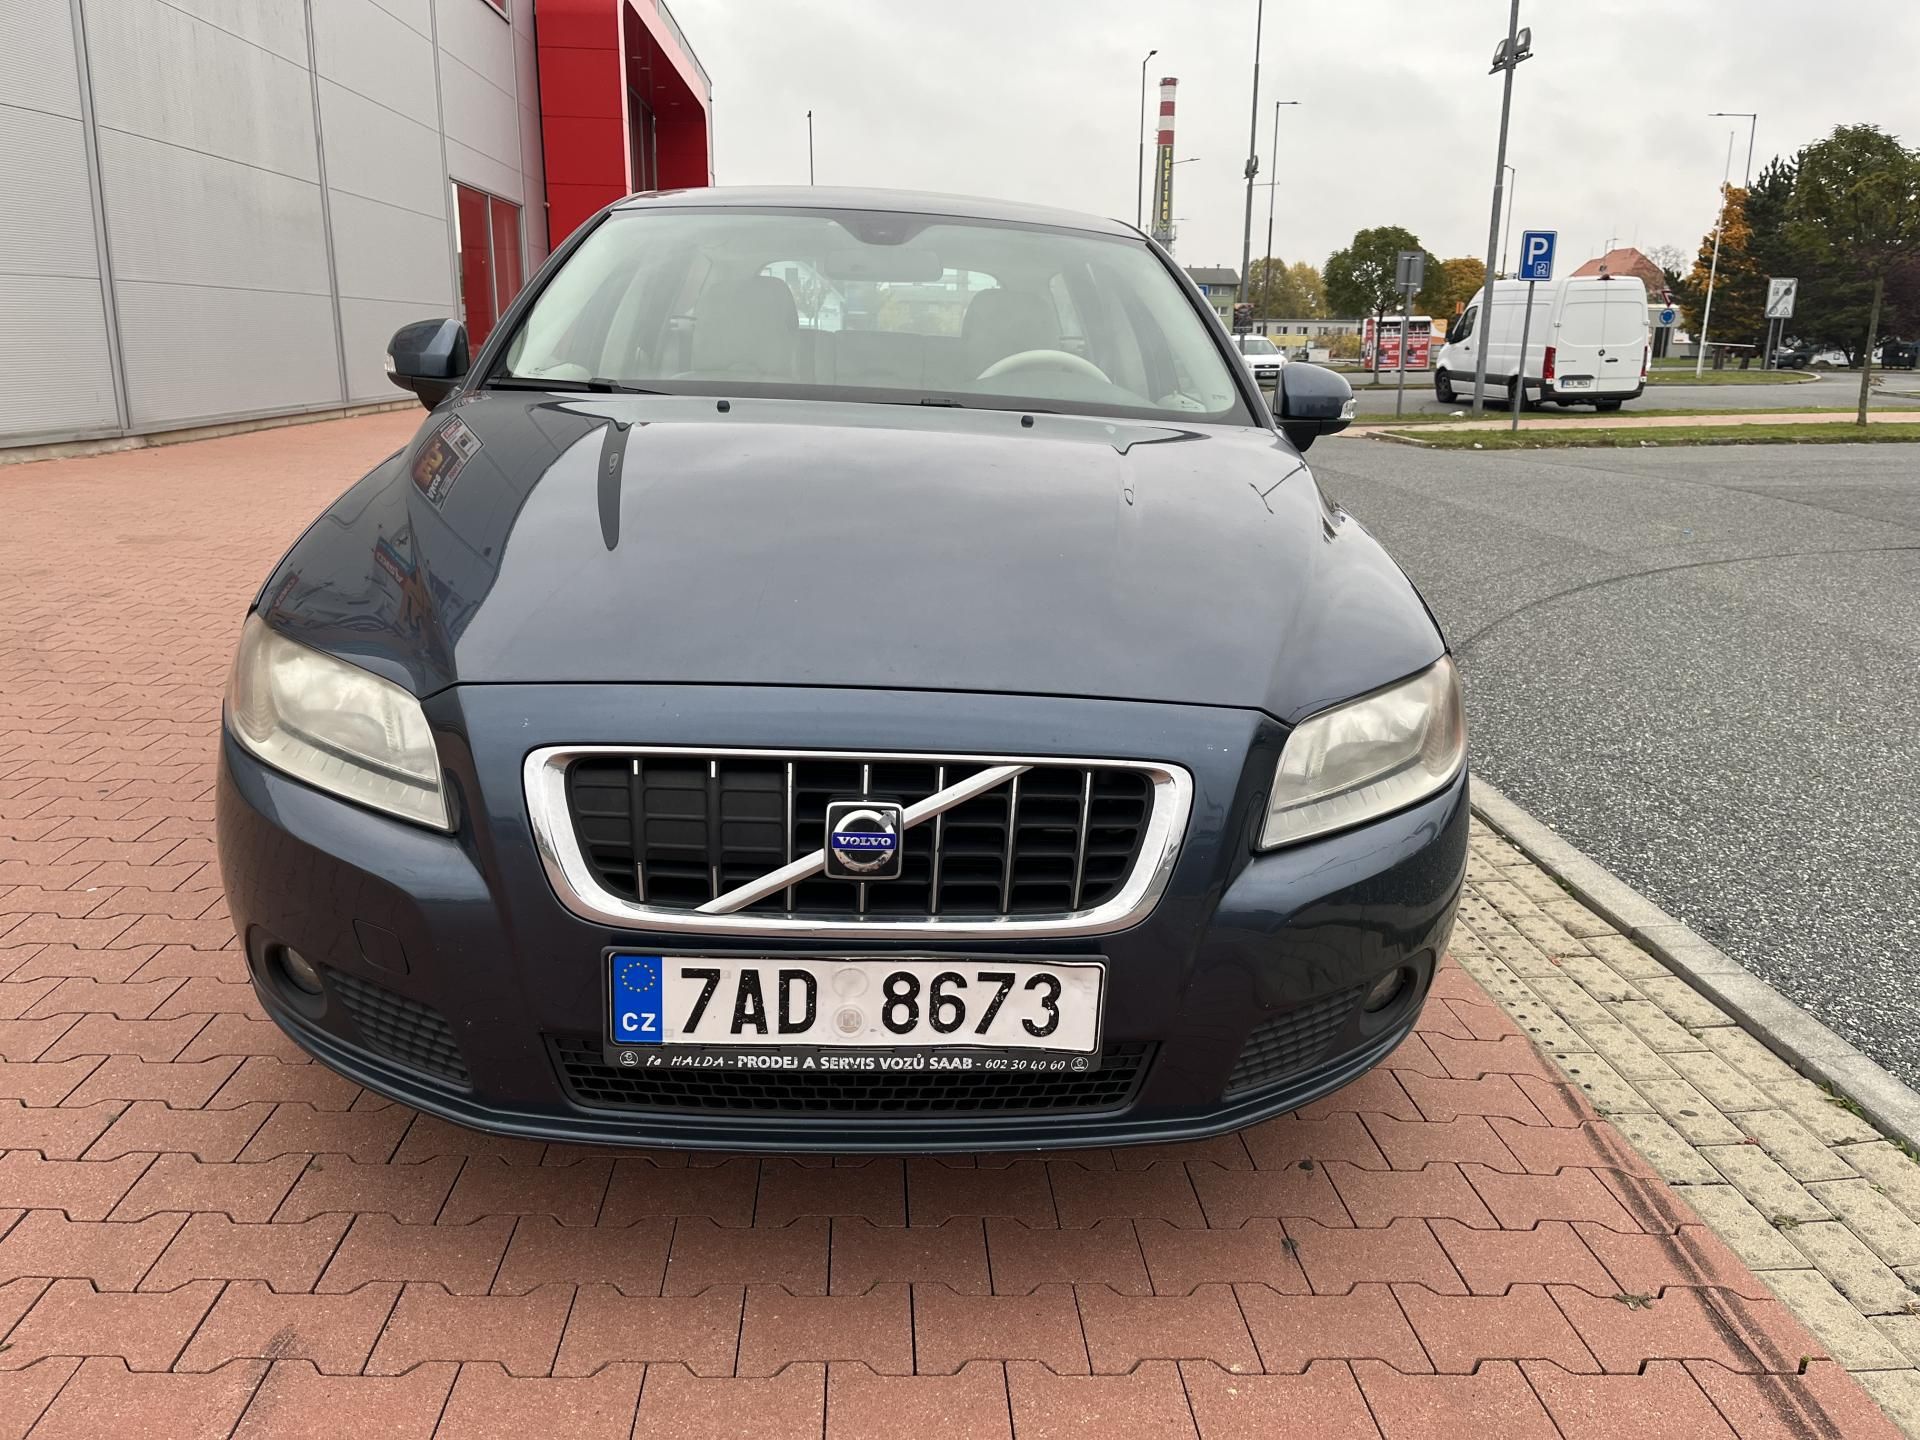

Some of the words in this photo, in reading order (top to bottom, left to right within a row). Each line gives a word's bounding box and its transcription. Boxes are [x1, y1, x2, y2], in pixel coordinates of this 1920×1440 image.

[1527, 237, 1549, 265] P
[837, 836, 891, 846] VOLVO
[681, 968, 818, 1035] 7AD
[882, 971, 1062, 1038] 8673
[622, 1012, 656, 1032] CZ
[671, 1055, 725, 1068] HALDA
[737, 1055, 798, 1069] PRODEJ
[803, 1056, 816, 1069] A
[821, 1056, 875, 1070] SERVIS
[880, 1053, 925, 1070] VOZŮ
[929, 1056, 972, 1070] SAAB
[985, 1061, 1007, 1070] 602
[1010, 1061, 1027, 1070] 30
[1030, 1061, 1046, 1071] 40
[1050, 1061, 1066, 1071] 60
